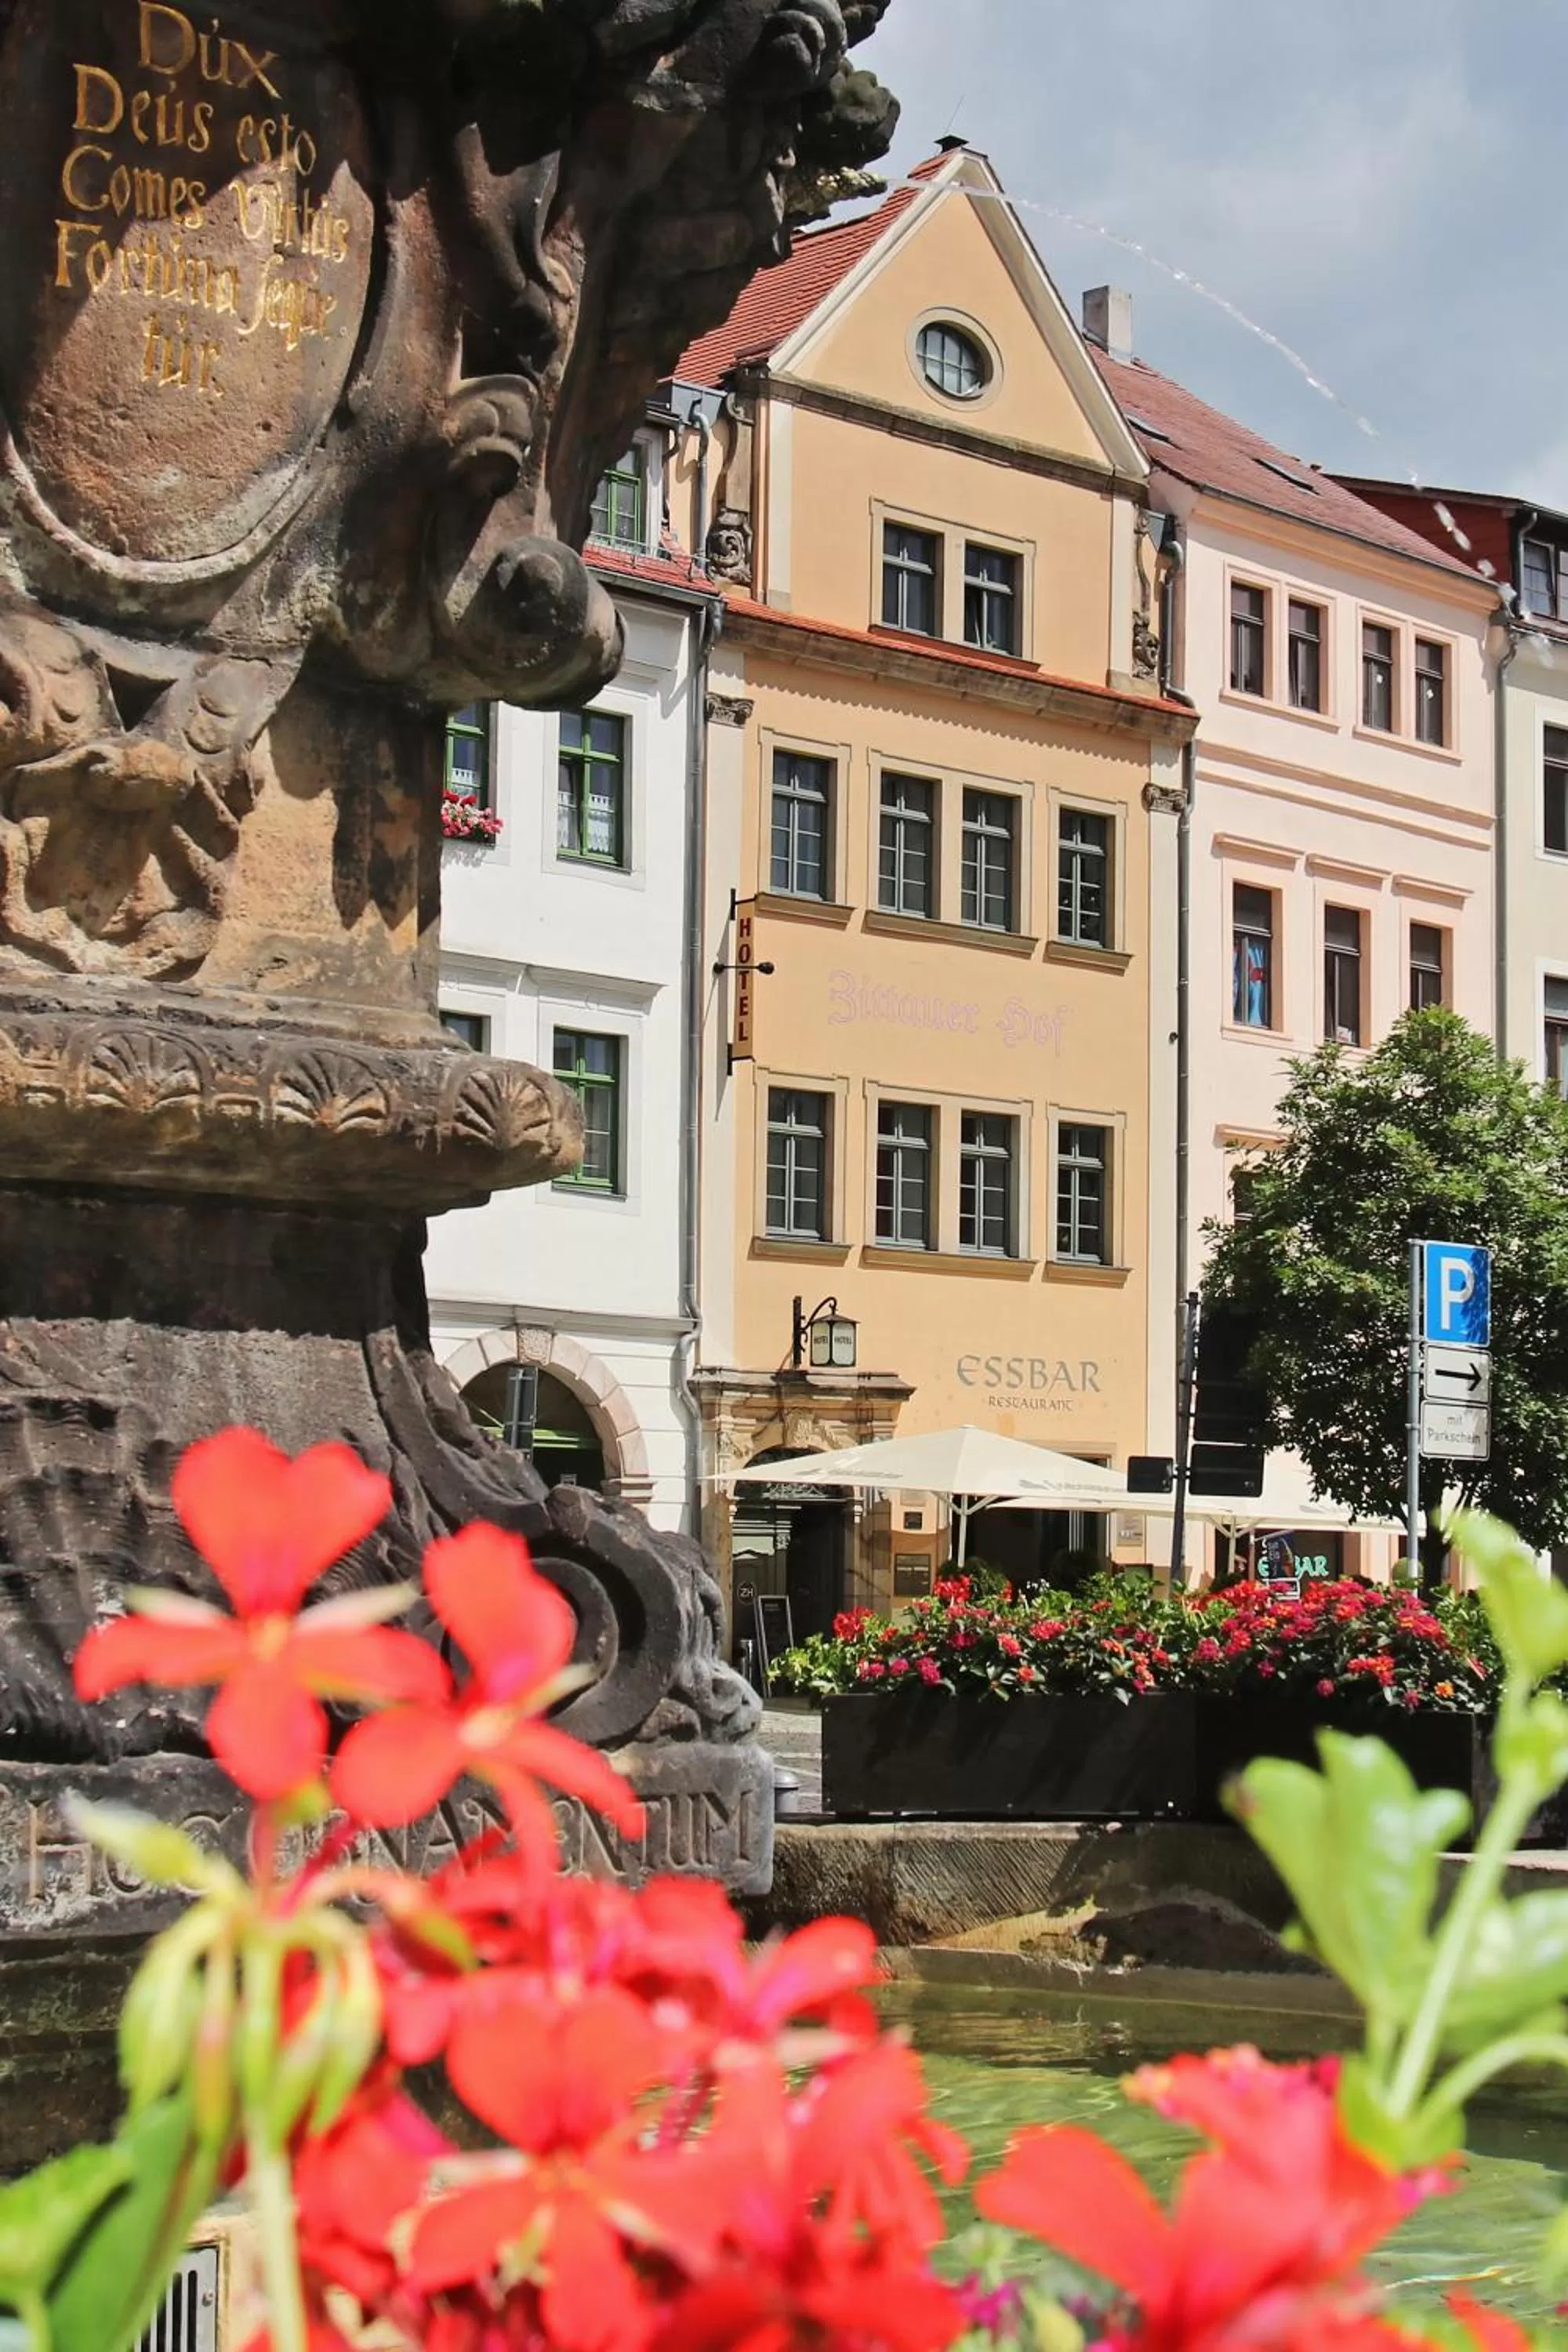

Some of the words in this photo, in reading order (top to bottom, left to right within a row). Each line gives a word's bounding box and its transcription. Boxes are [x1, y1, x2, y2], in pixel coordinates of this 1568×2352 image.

[236, 112, 317, 176] esto
[62, 145, 207, 229] Comes
[738, 916, 752, 1042] HOTEL
[996, 996, 1067, 1058] Hof
[1440, 1257, 1475, 1330] P
[956, 1355, 1102, 1393] ESSBAR
[988, 1395, 1074, 1412] RESTAURANT
[739, 1588, 753, 1597] ZH
